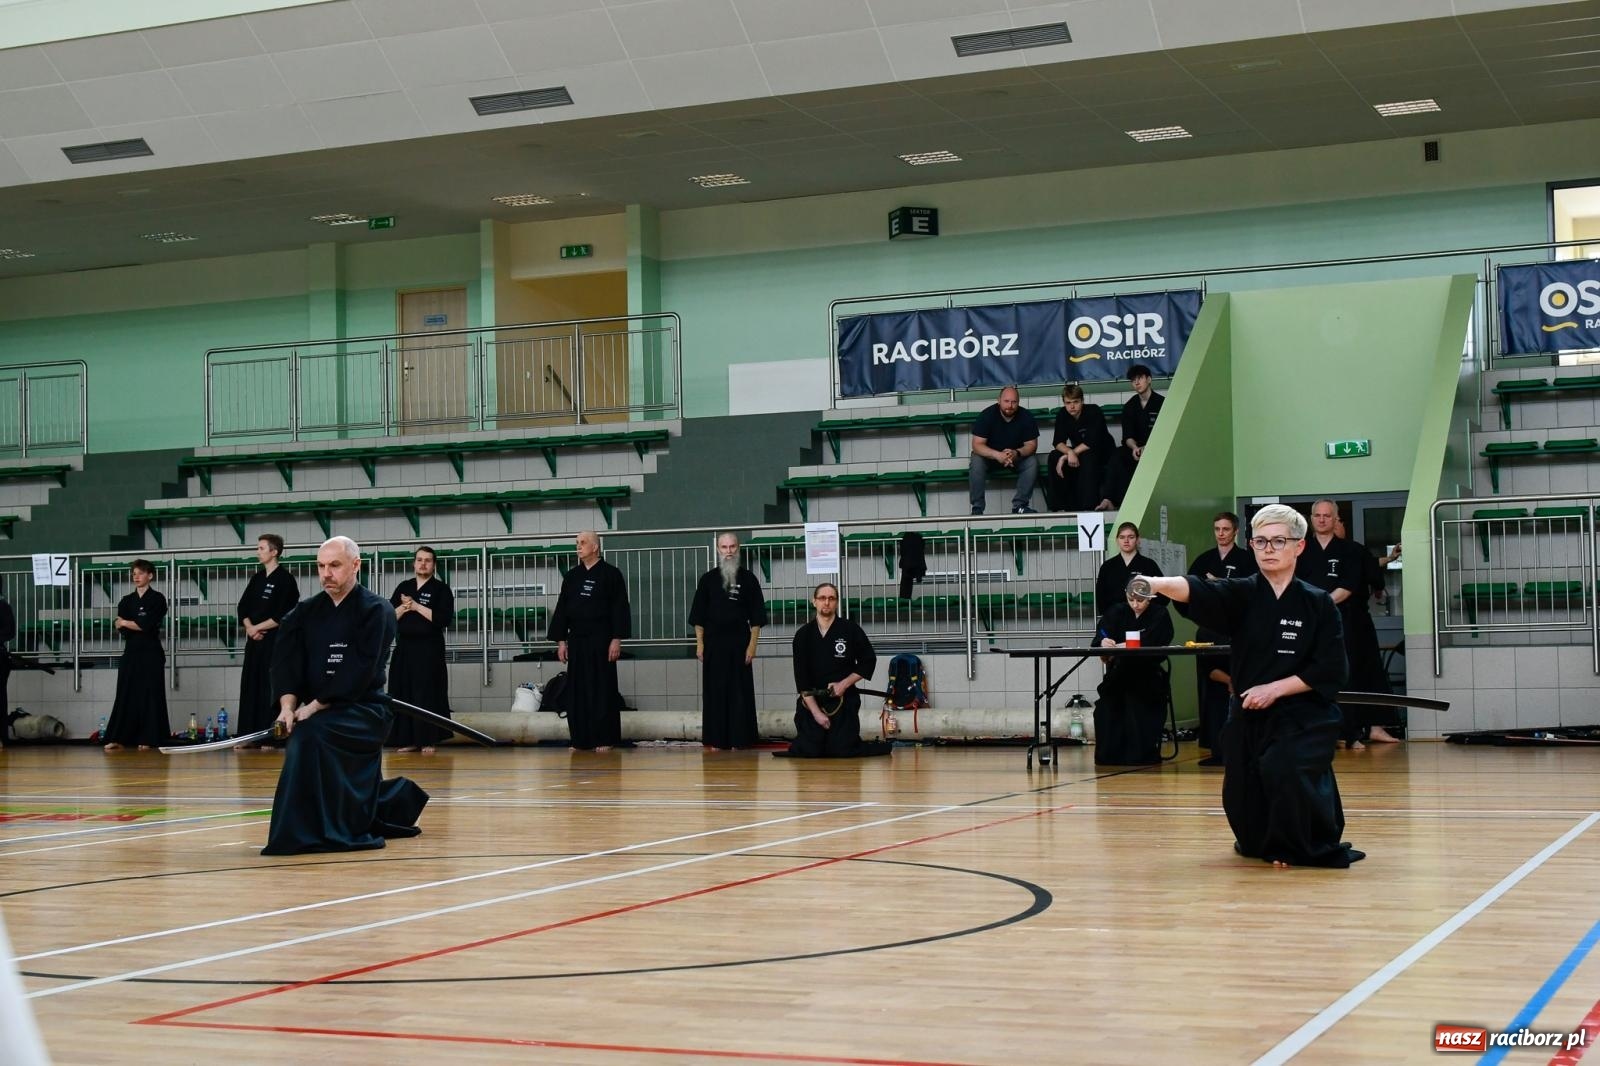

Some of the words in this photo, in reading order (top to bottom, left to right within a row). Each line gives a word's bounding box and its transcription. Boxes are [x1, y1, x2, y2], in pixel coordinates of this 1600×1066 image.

[892, 218, 899, 235] E
[912, 216, 929, 232] E
[1067, 312, 1165, 349] OSiR
[872, 328, 1019, 365] RACIBÓRZ
[1106, 345, 1165, 361] RACIBÓRZ
[1080, 524, 1100, 548] Y
[54, 557, 67, 576] Z
